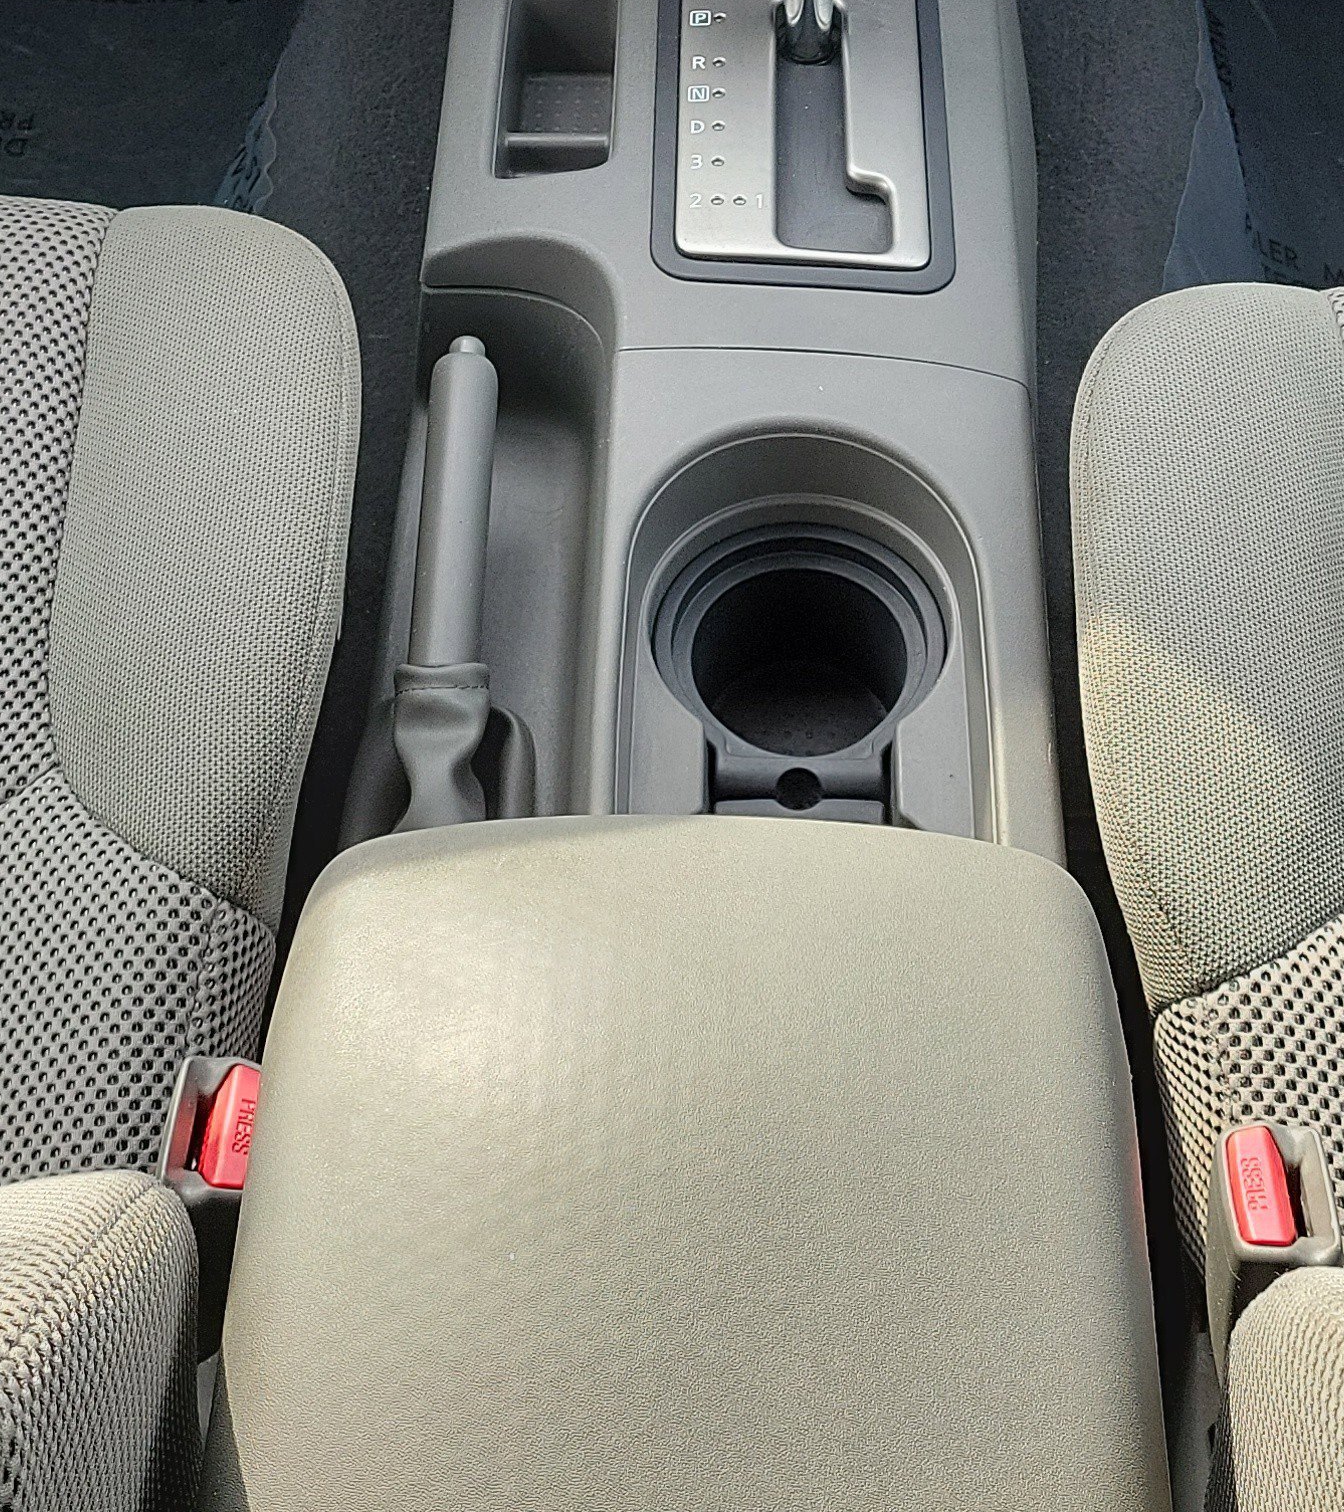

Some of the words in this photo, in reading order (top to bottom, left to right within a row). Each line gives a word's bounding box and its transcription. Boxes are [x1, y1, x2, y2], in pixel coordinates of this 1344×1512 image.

[692, 56, 706, 69] R
[690, 120, 705, 134] D
[690, 155, 703, 169] 3
[689, 194, 702, 208] 2
[756, 194, 764, 208] 1
[232, 1097, 257, 1156] PRESS
[1240, 1157, 1269, 1212] PRESS
